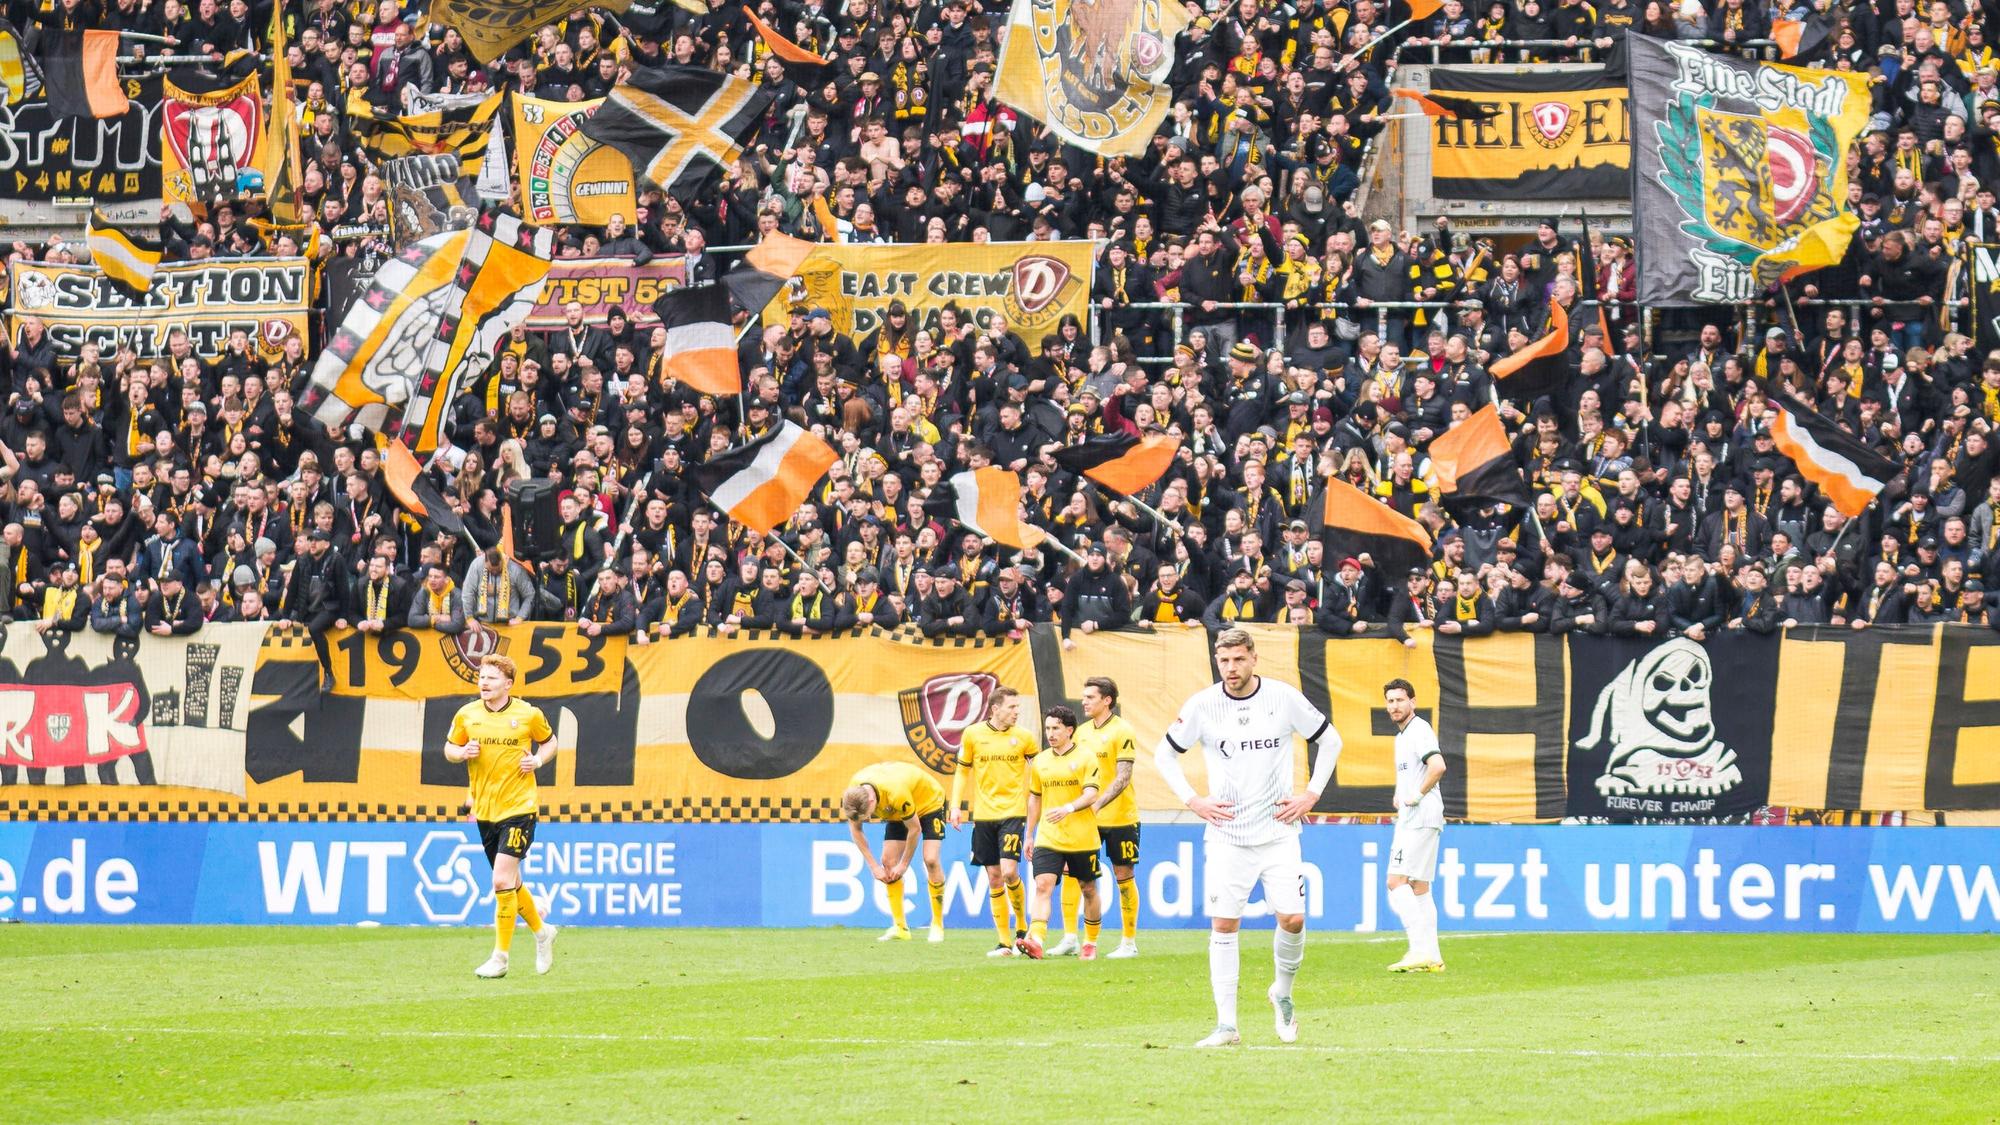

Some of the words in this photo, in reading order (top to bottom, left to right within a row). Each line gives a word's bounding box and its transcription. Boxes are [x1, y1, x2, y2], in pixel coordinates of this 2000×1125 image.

[522, 103, 545, 125] 53
[534, 180, 547, 189] 0
[575, 180, 629, 197] GEWINNT
[841, 271, 918, 298] EAST
[927, 270, 1014, 298] CREW
[336, 630, 421, 687] 19
[524, 625, 608, 687] 53
[1241, 737, 1281, 751] FIEGE
[1606, 795, 1664, 812] FOREVER
[507, 826, 522, 848] 18
[1003, 833, 1020, 852] 27
[1121, 840, 1135, 859] 13
[1089, 854, 1098, 872] 7
[257, 840, 408, 914] WT
[524, 841, 677, 875] ENERGIE
[1584, 848, 1836, 921] unter:
